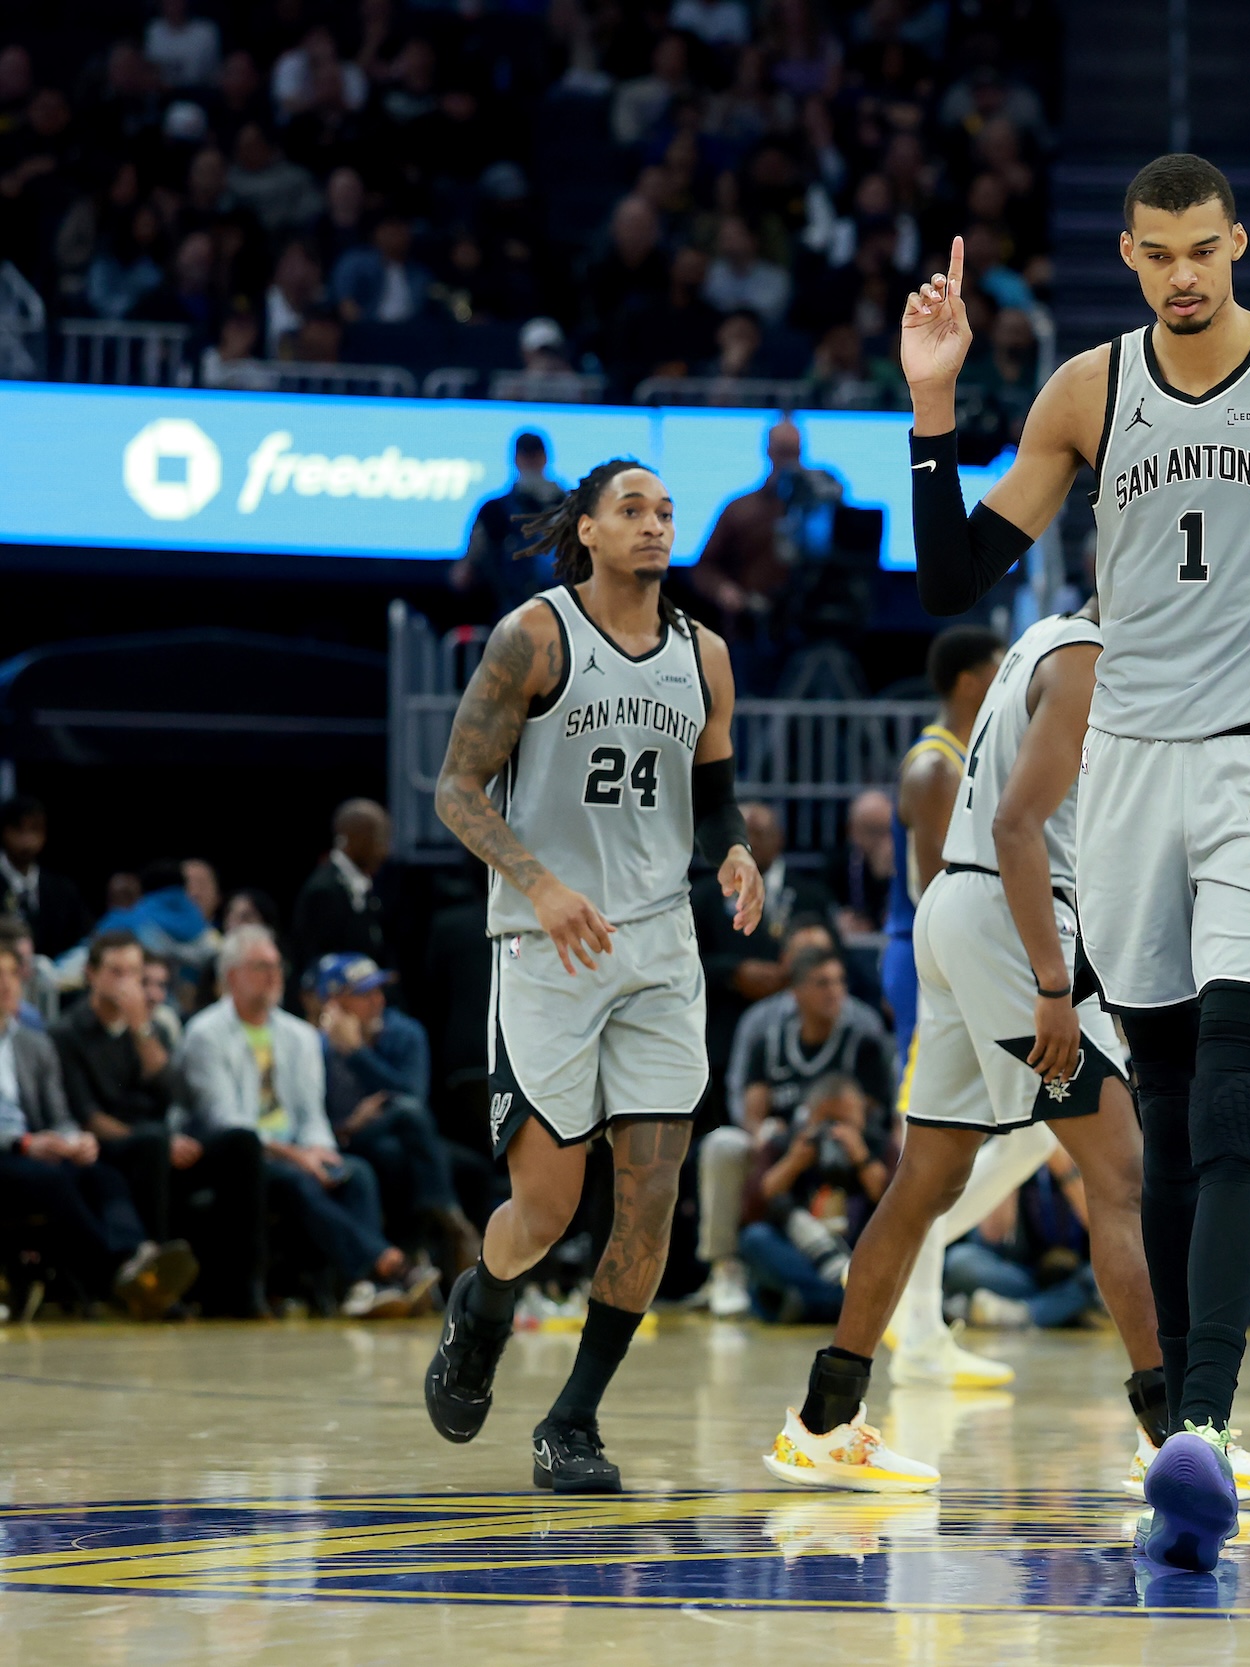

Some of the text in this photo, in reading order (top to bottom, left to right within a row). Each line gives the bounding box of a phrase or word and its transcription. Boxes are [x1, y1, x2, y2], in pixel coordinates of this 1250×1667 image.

[237, 430, 471, 514] freedom
[1115, 452, 1160, 513] SAN
[1177, 509, 1210, 583] 1
[661, 675, 687, 684] LEDGER
[565, 695, 699, 752] SAN ANTONIO
[581, 743, 663, 811] 24
